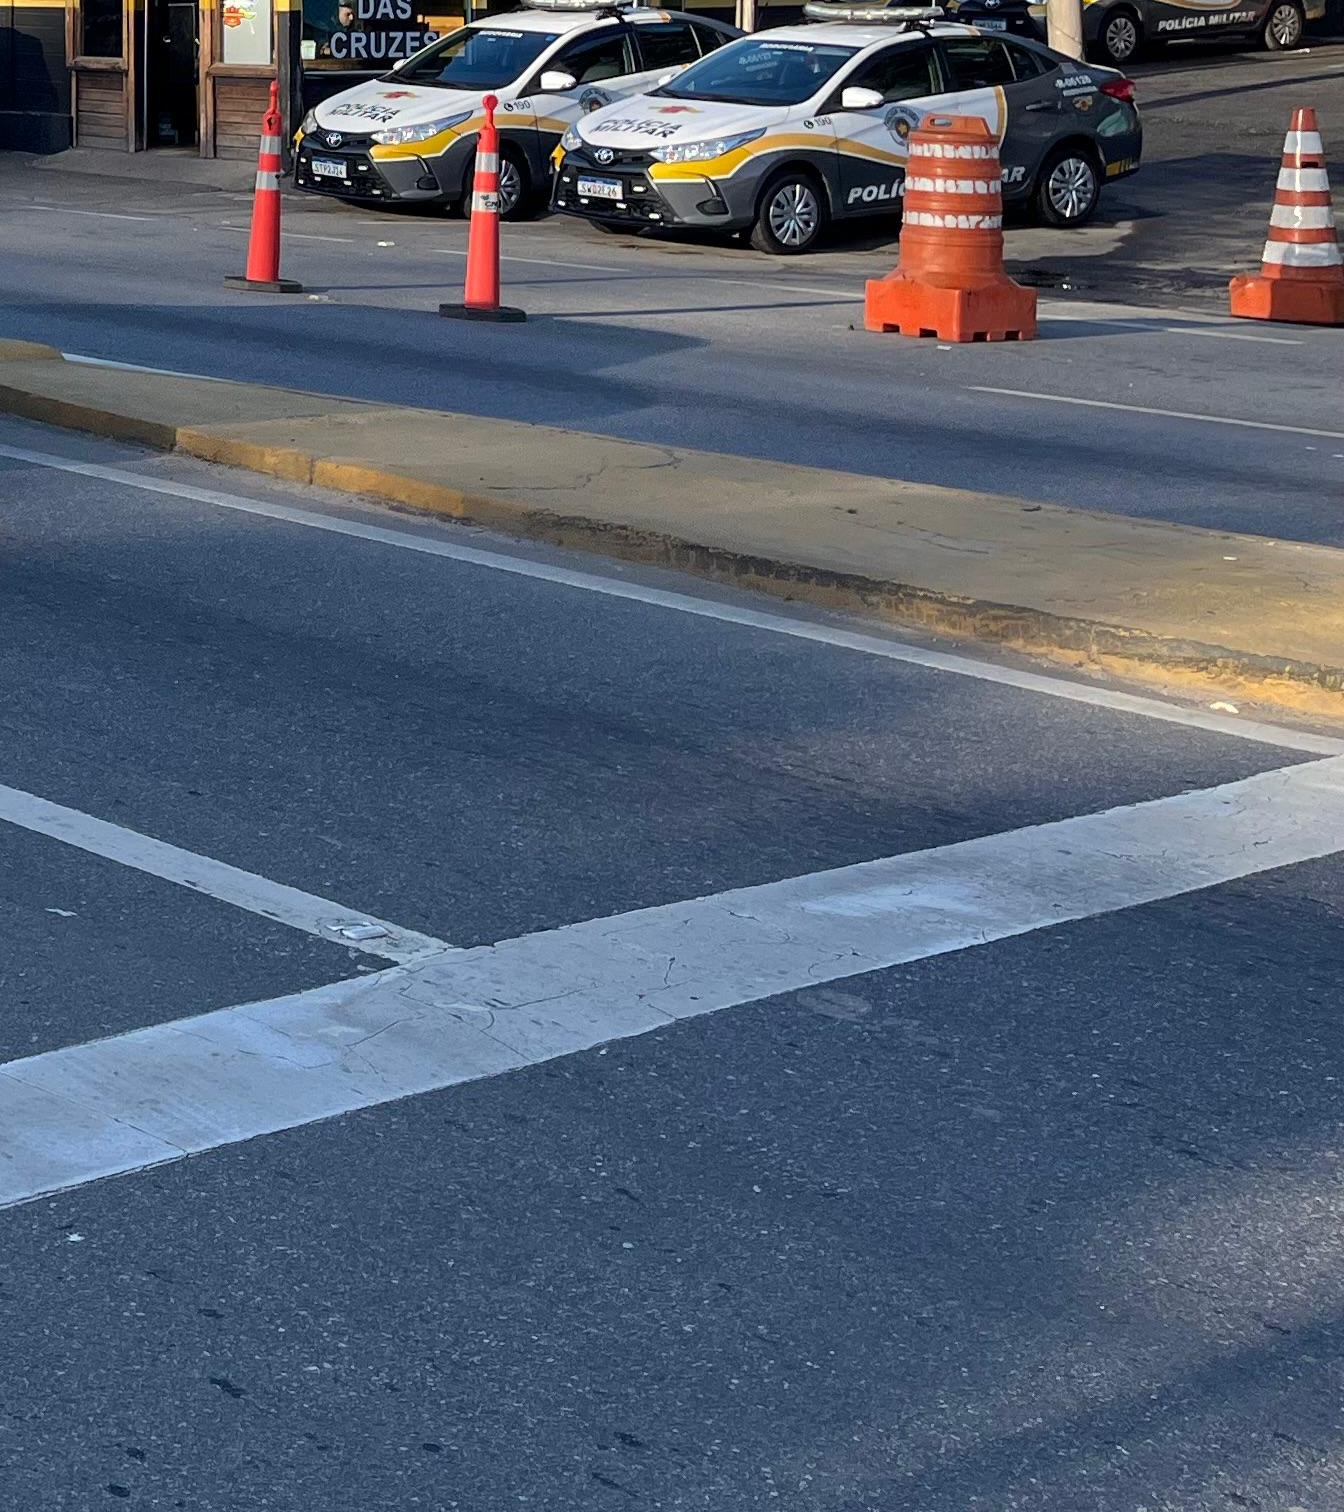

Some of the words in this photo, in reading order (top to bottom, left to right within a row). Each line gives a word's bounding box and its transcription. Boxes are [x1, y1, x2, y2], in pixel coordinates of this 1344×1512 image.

[1158, 17, 1206, 31] POLÍCIA
[1208, 11, 1256, 25] MILITAR
[513, 100, 531, 110] 190
[814, 117, 832, 126] 190
